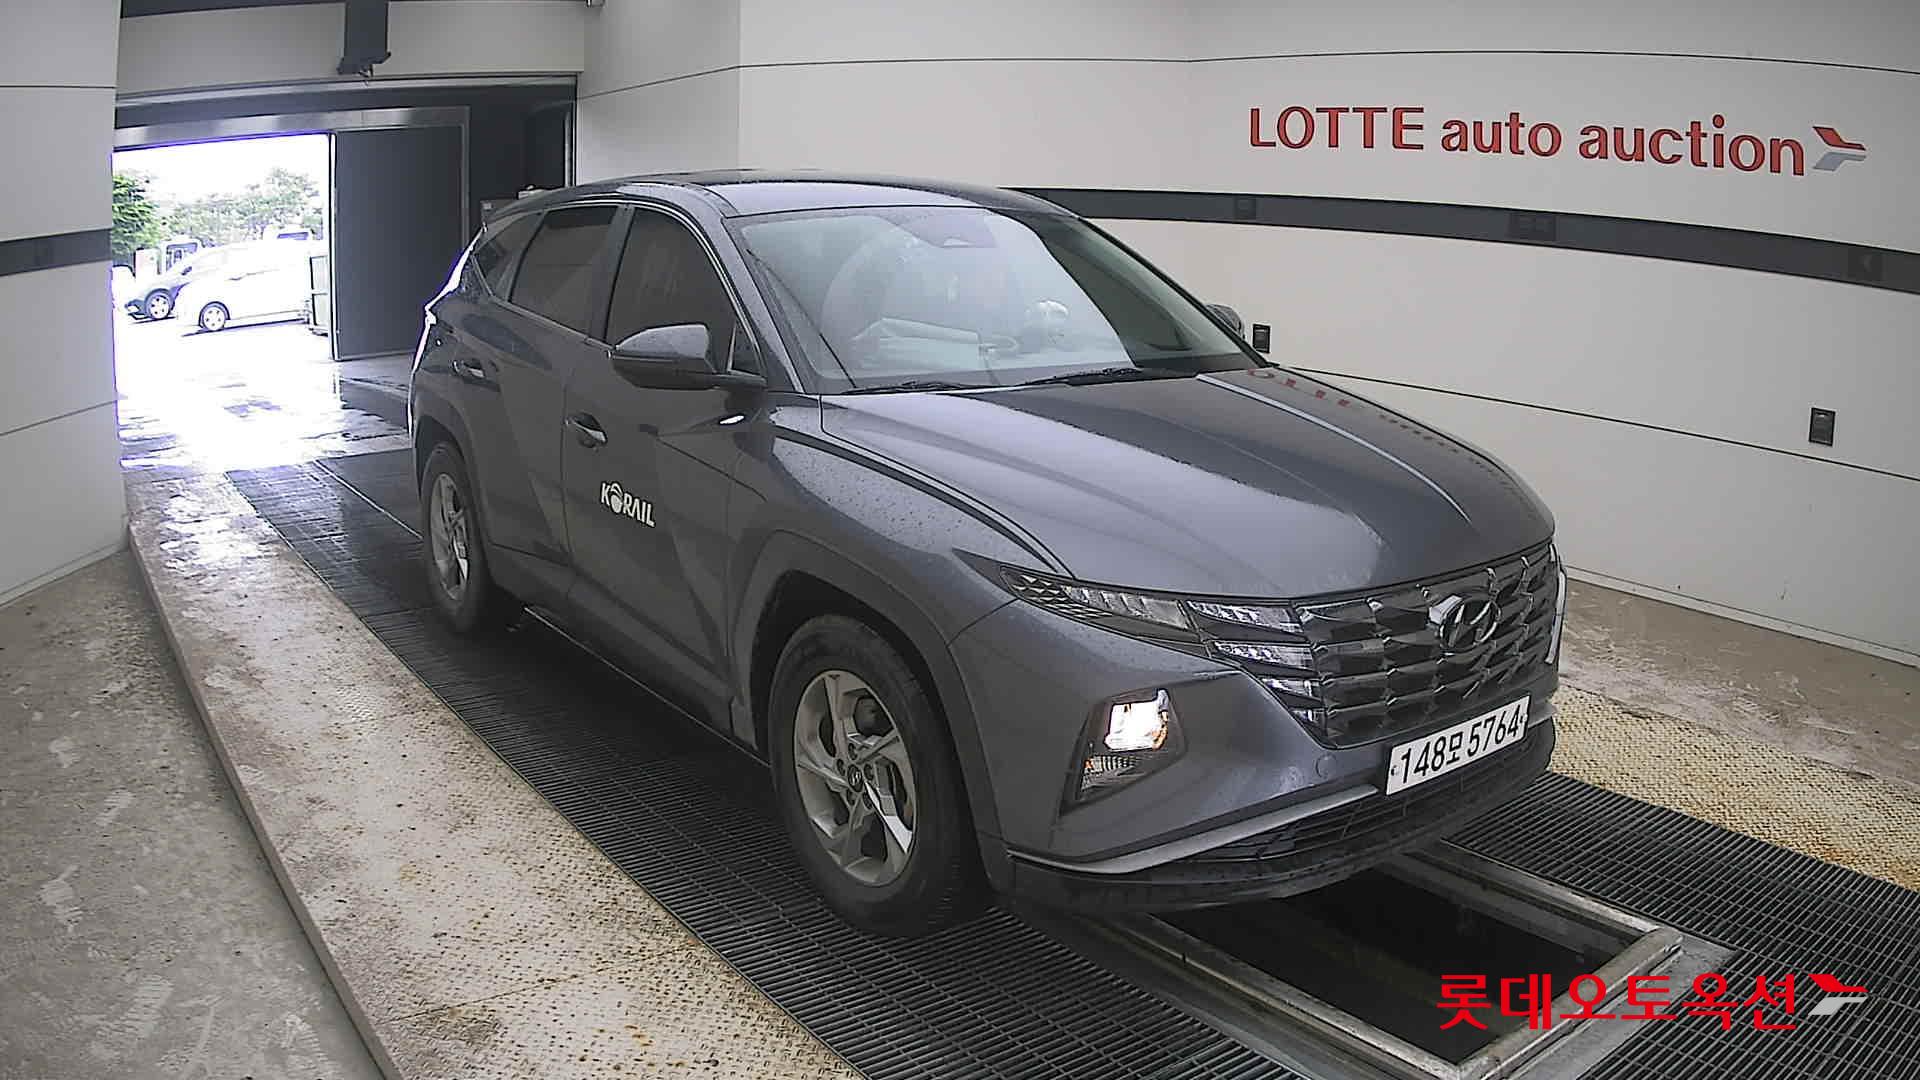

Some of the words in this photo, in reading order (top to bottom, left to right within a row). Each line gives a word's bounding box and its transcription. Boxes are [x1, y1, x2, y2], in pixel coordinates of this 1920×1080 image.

[1250, 106, 1425, 150] LOTTE
[1441, 112, 1562, 157] auto
[1578, 114, 1805, 176] auction
[600, 481, 656, 528] KORAIL
